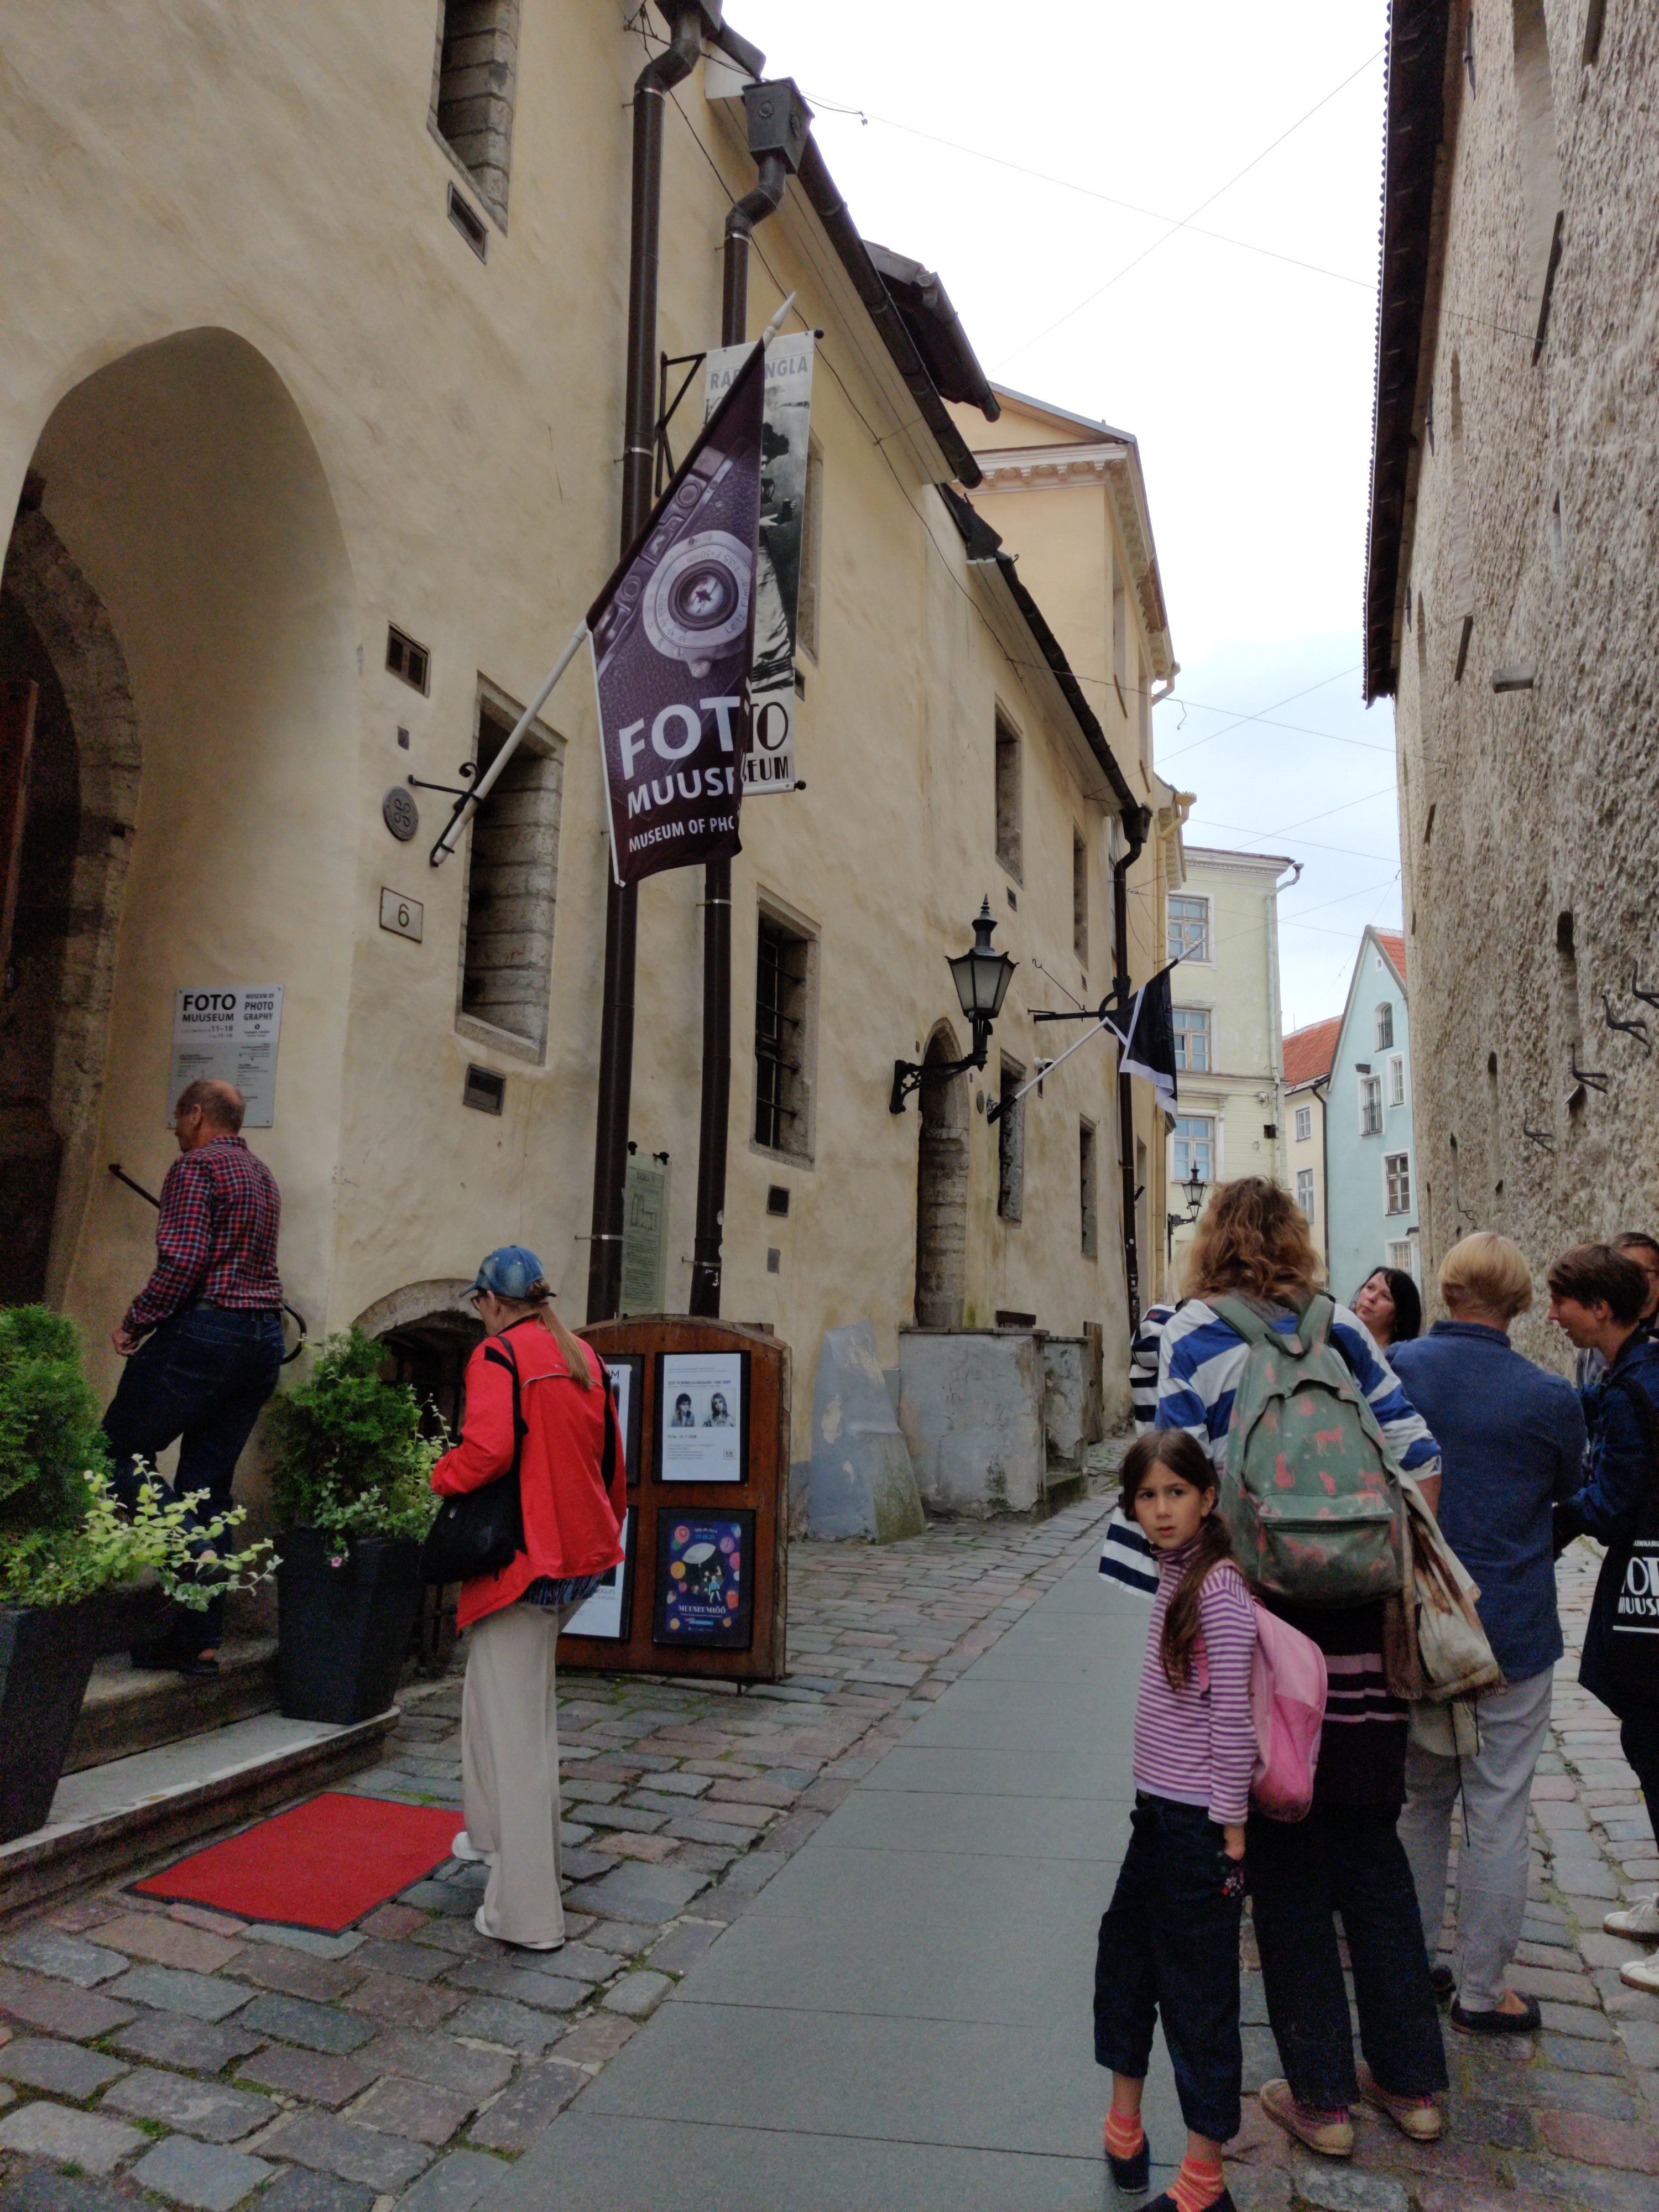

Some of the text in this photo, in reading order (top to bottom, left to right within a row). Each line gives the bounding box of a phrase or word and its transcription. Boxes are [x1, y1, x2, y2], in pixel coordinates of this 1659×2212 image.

[618, 696, 741, 780] FOT
[744, 756, 789, 782] EUM
[629, 821, 685, 853] MUSEUM
[688, 818, 706, 834] OF
[398, 903, 409, 928] 6
[182, 993, 237, 1011] FOTO
[244, 1001, 274, 1011] PHOTO
[182, 1013, 234, 1022] MUUSEUM
[243, 1013, 273, 1021] GRAPHY
[1623, 1557, 1659, 1597] OT
[1618, 1597, 1659, 1615] MUUS
